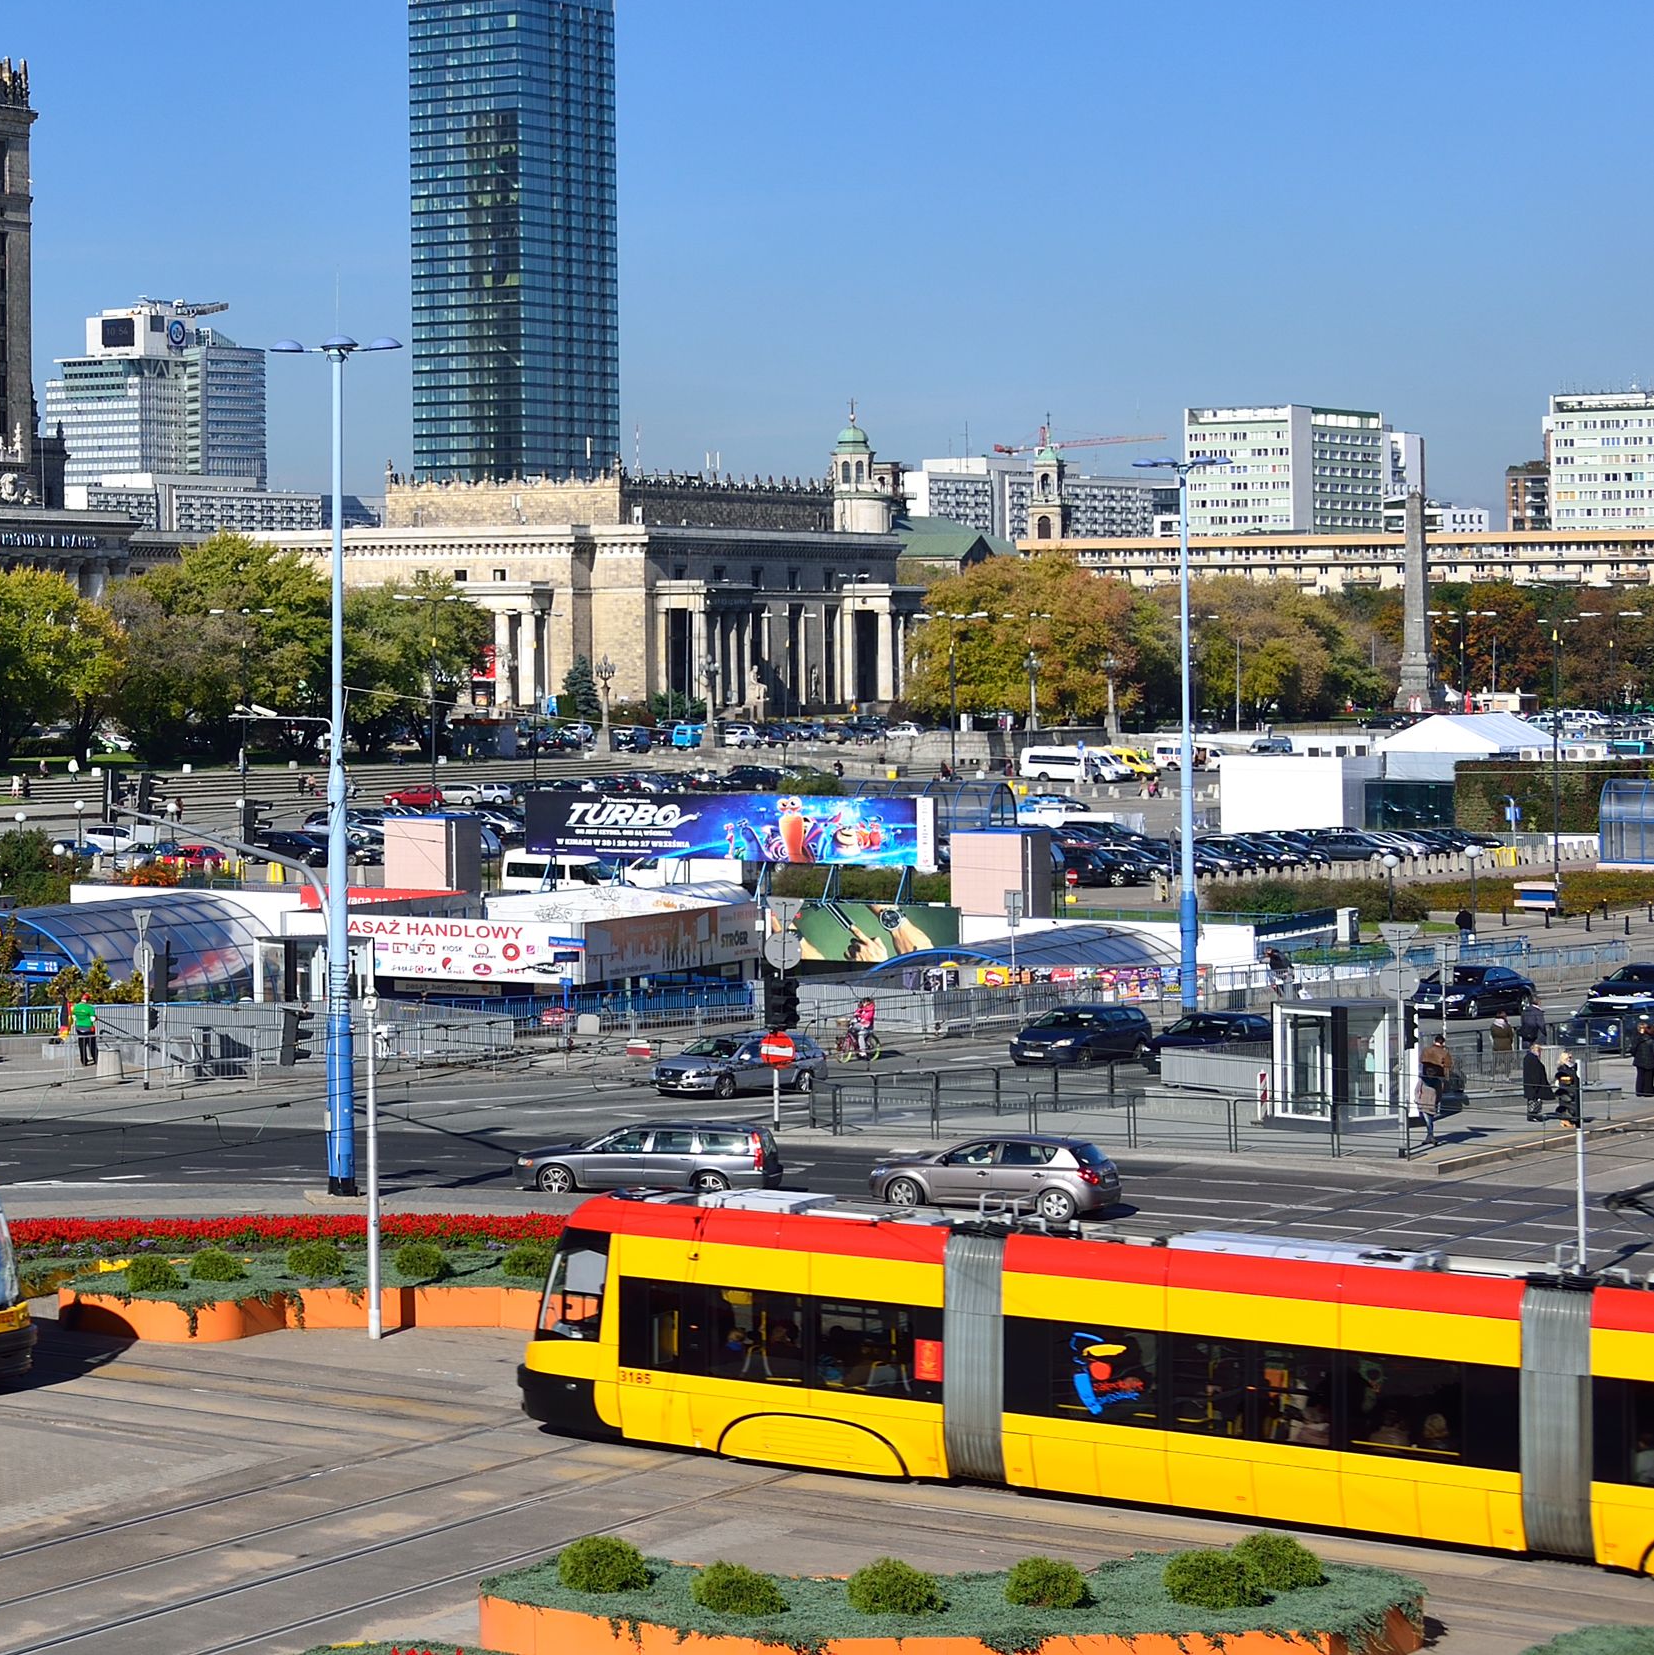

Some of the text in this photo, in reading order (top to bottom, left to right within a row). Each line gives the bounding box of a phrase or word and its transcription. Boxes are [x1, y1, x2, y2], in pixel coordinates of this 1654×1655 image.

[565, 802, 685, 828] TURBO
[347, 920, 524, 940] ASAŻ HANDLOWY
[620, 1370, 652, 1385] 3185
